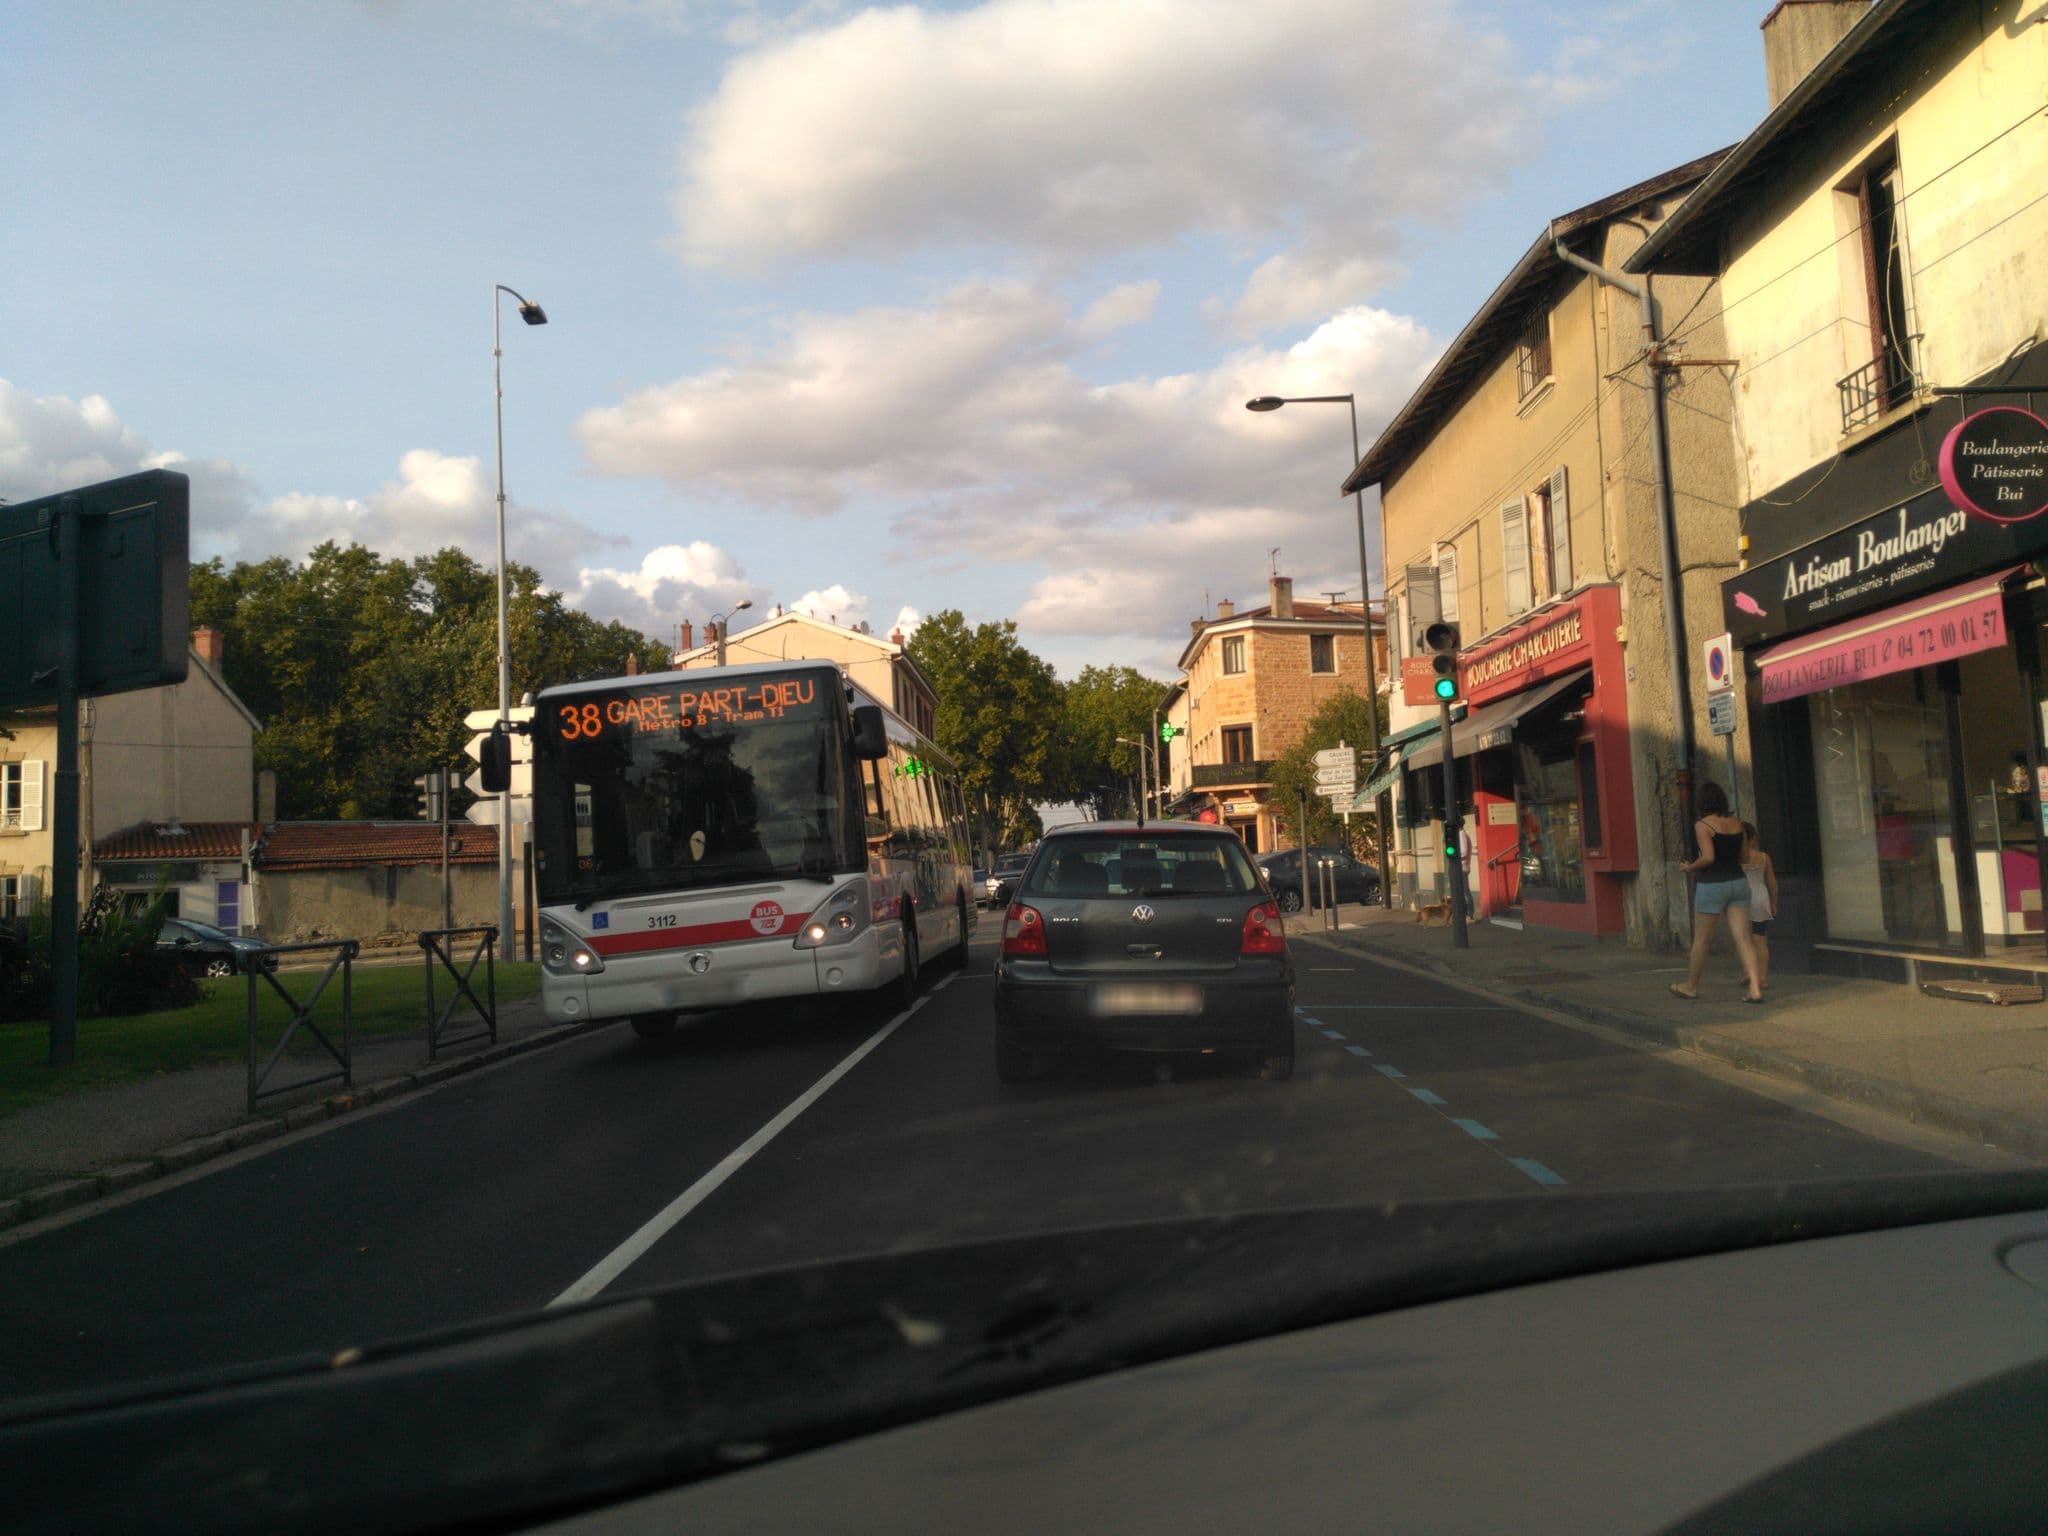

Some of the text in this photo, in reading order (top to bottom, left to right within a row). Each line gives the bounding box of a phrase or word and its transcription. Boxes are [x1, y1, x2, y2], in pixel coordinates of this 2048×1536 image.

[1962, 438, 2048, 458] Boulangerie
[1972, 464, 2044, 479] Pâtisserie
[1997, 486, 2024, 501] Bui
[1783, 508, 1967, 600] Artisan Boulanger
[1808, 588, 1830, 611] snack
[1467, 615, 1582, 689] BOUCHERIE CHARCUTERIE
[1763, 608, 1998, 694] BOULANGERIE BUI 04 72 00 01 57
[560, 679, 814, 740] 38 GARE PART-DIEU
[640, 716, 692, 732] Métro
[697, 714, 708, 726] B
[726, 711, 764, 723] Tram
[648, 914, 677, 928] 3112
[756, 906, 778, 917] BUS
